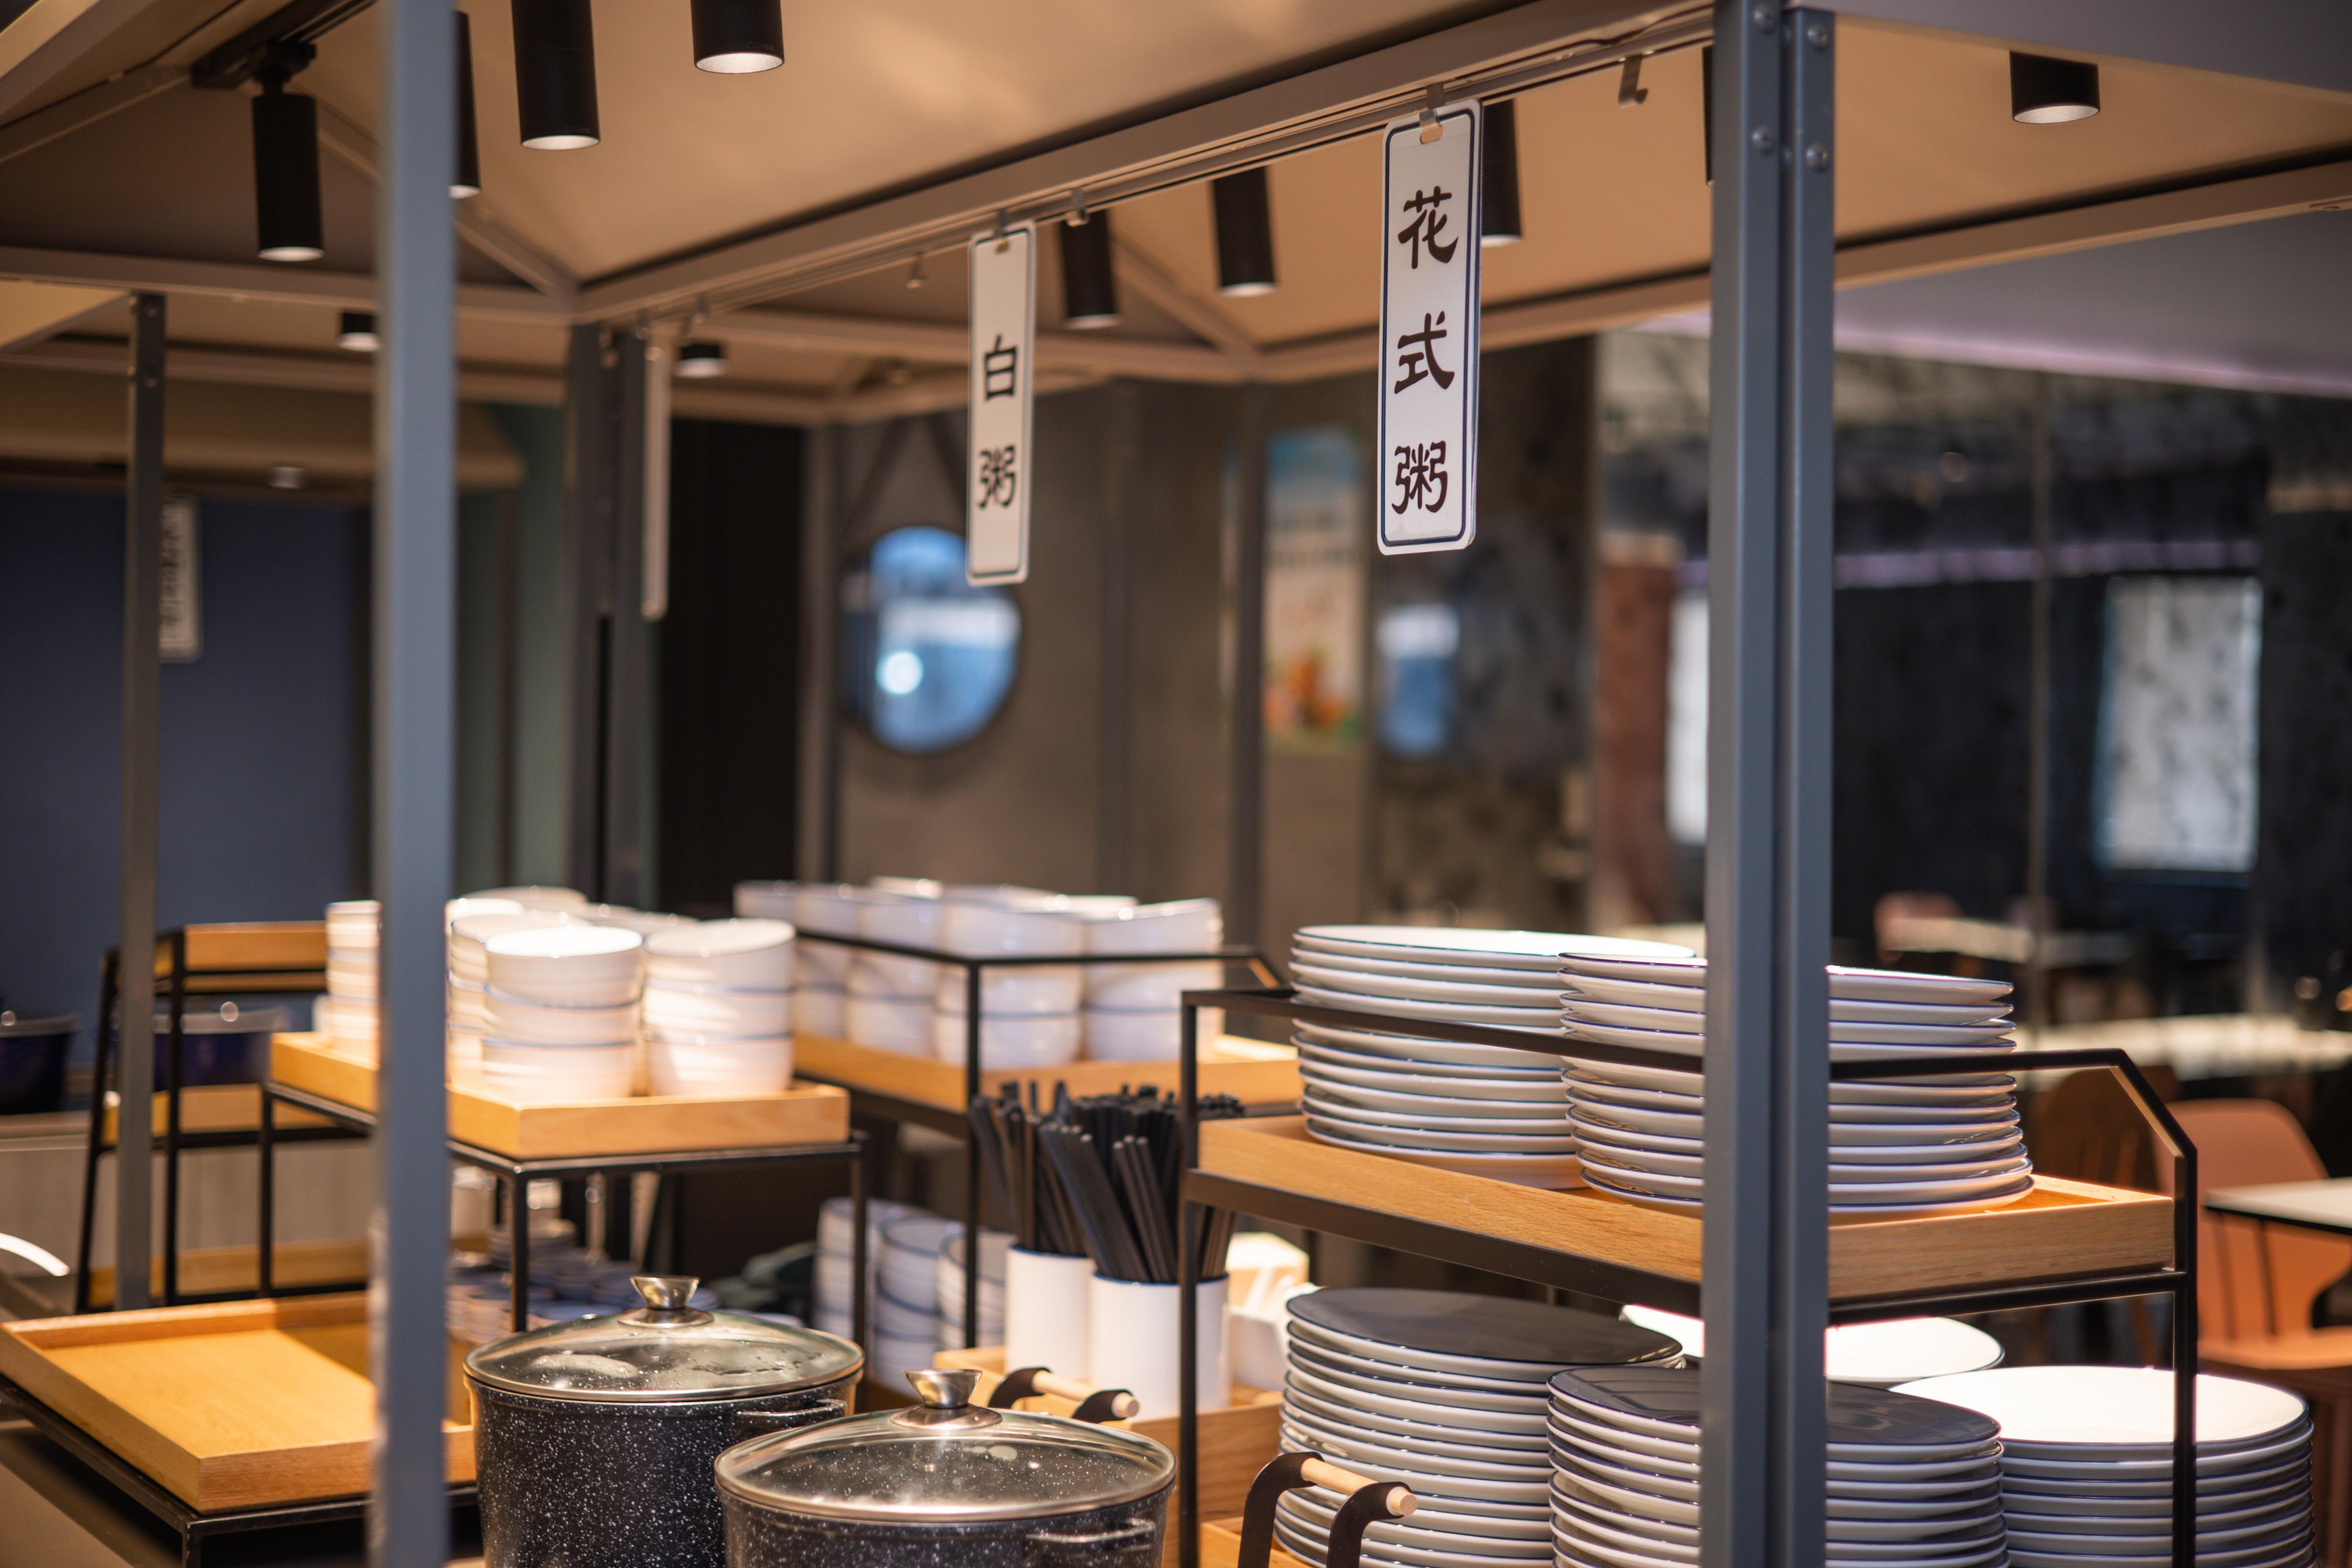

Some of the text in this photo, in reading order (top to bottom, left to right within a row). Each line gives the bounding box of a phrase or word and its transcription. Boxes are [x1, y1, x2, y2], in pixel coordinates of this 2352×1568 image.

[977, 335, 1018, 509] 白粥
[1391, 185, 1459, 514] 花式粥
